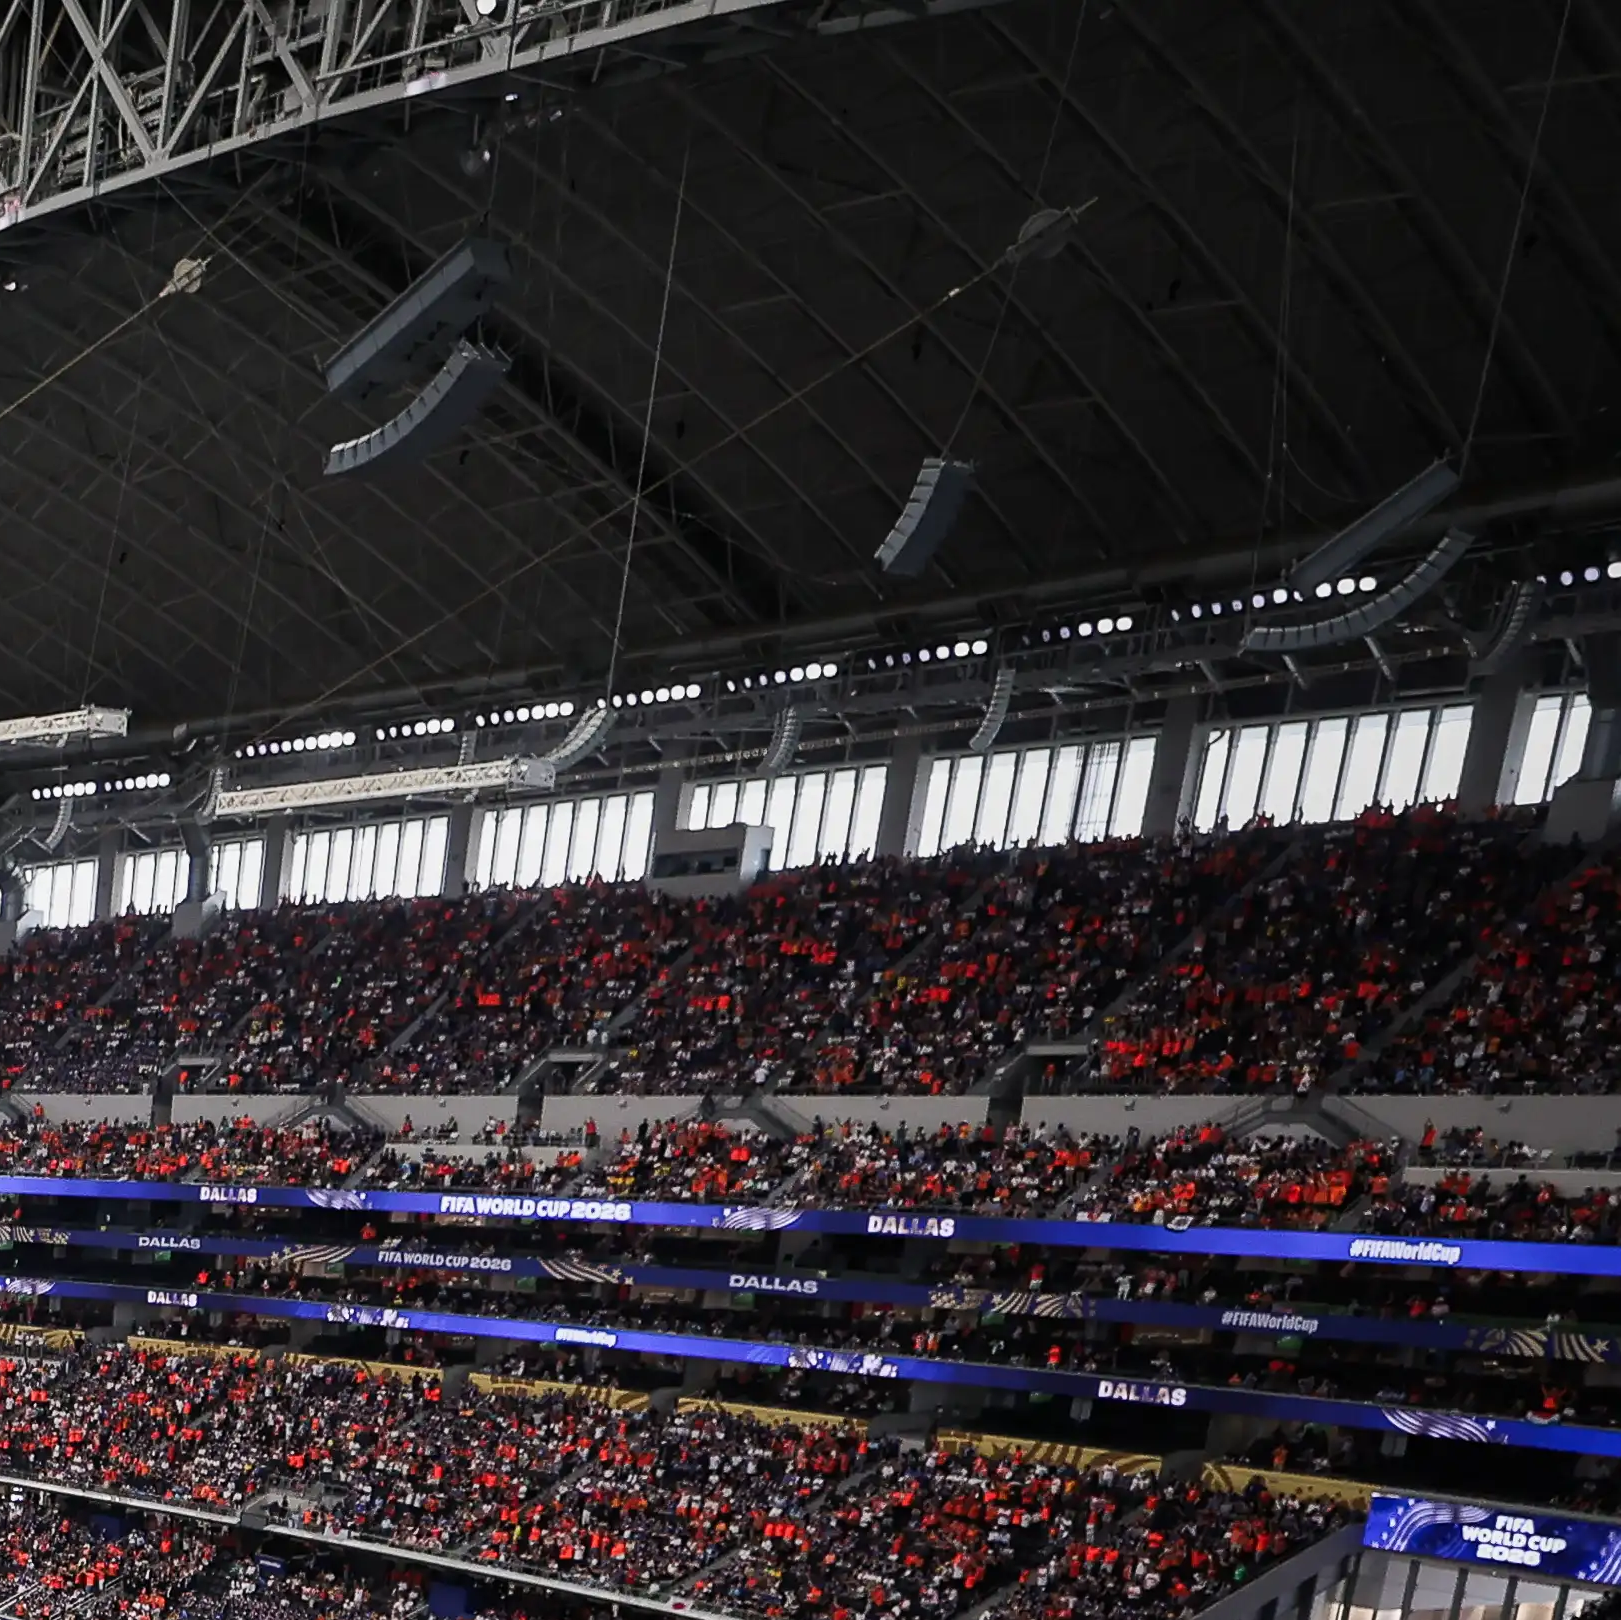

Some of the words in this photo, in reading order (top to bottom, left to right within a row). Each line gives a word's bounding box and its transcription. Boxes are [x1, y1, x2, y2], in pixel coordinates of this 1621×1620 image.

[199, 1186, 257, 1204] DALLAS
[440, 1195, 476, 1214] FIFA
[479, 1196, 534, 1217] WORLD
[534, 1199, 570, 1218] CUP
[570, 1200, 632, 1222] 2026
[867, 1215, 955, 1238] DALLAS
[138, 1236, 201, 1250] DALLAS
[377, 1250, 403, 1263] FIFA
[404, 1252, 441, 1267] WORLD
[442, 1255, 467, 1268] CUP
[469, 1256, 512, 1272] 2026
[728, 1274, 819, 1294] DALLAS
[147, 1290, 198, 1308] DALLAS
[1221, 1310, 1319, 1335] #FIFAWorldCup
[1097, 1380, 1187, 1406] DALLAS
[1495, 1515, 1535, 1535] FIFA
[1461, 1525, 1527, 1549] WORLD
[1527, 1536, 1567, 1555] CUP
[1476, 1544, 1541, 1567] 2026
